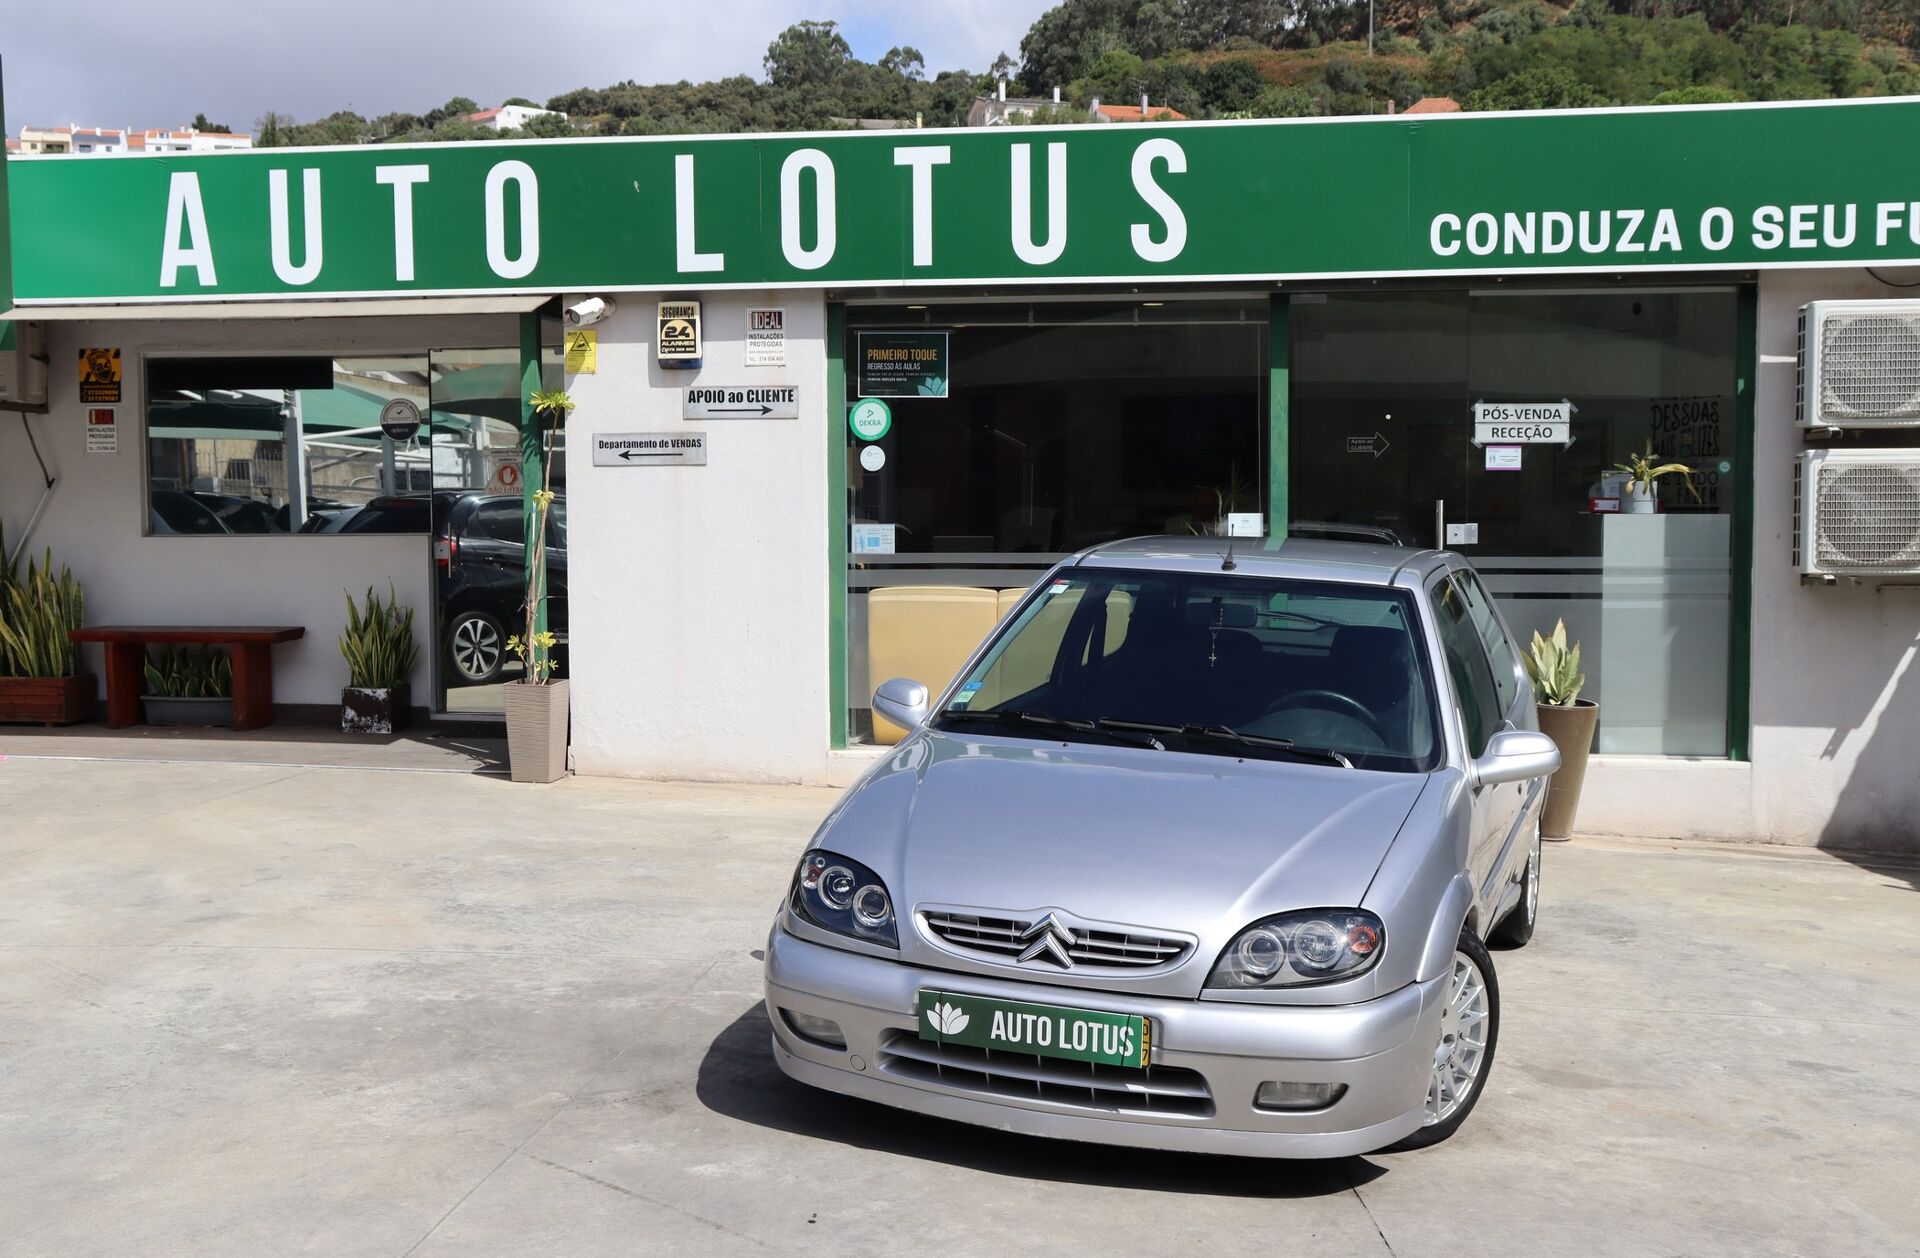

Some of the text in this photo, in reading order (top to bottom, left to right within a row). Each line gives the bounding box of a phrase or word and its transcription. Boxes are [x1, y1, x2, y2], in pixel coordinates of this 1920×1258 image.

[161, 139, 1187, 287] AUTO LOTUS
[1430, 208, 1682, 257] CONDUZA
[1700, 208, 1734, 250] O
[1752, 204, 1857, 250] SEU
[661, 305, 695, 319] SEGURANÇA
[754, 311, 782, 329] IDEAL
[664, 325, 690, 339] 24
[748, 333, 784, 341] INSTALAÇÕES
[867, 348, 938, 361] PRIMEIRO TOQUE
[867, 361, 921, 370] REGRESSO ÀS AULAS
[688, 388, 794, 404] APOIO ao CLIENTE
[1482, 406, 1562, 420] PÓS-VENDA
[1650, 401, 1720, 436] PESSOAS
[859, 419, 882, 427] DEKRA
[1491, 424, 1553, 441] RECEÇÃO
[598, 439, 702, 450] Departamento de VENDAS
[991, 1010, 1135, 1057] AUTO LOTUS
